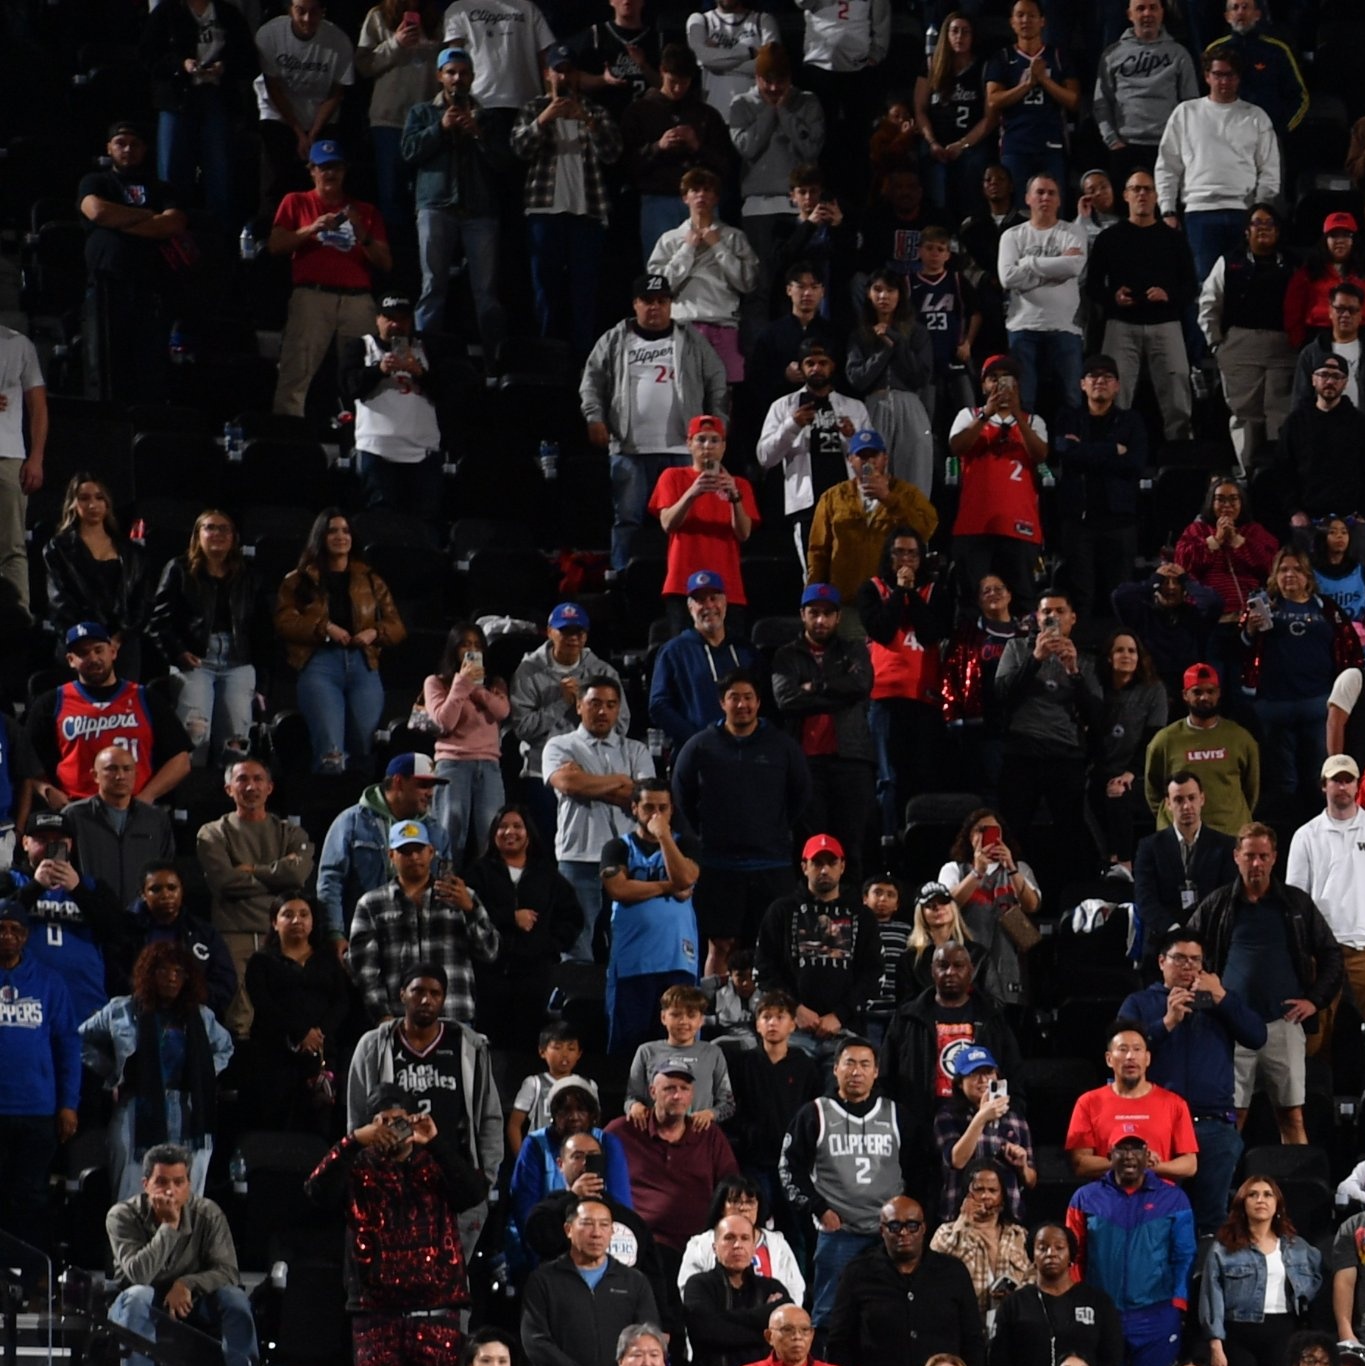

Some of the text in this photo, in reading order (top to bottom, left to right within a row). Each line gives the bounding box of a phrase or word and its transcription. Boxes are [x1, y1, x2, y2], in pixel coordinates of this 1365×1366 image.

[839, 2, 850, 20] 2
[1119, 51, 1173, 79] Clips
[957, 107, 970, 128] 2
[926, 314, 948, 332] 23
[628, 347, 676, 367] Clipper
[1009, 459, 1022, 481] 2
[62, 711, 139, 744] Clippers
[192, 942, 211, 961] C
[828, 1132, 893, 1157] CLIPPERS
[855, 1157, 872, 1184] 2
